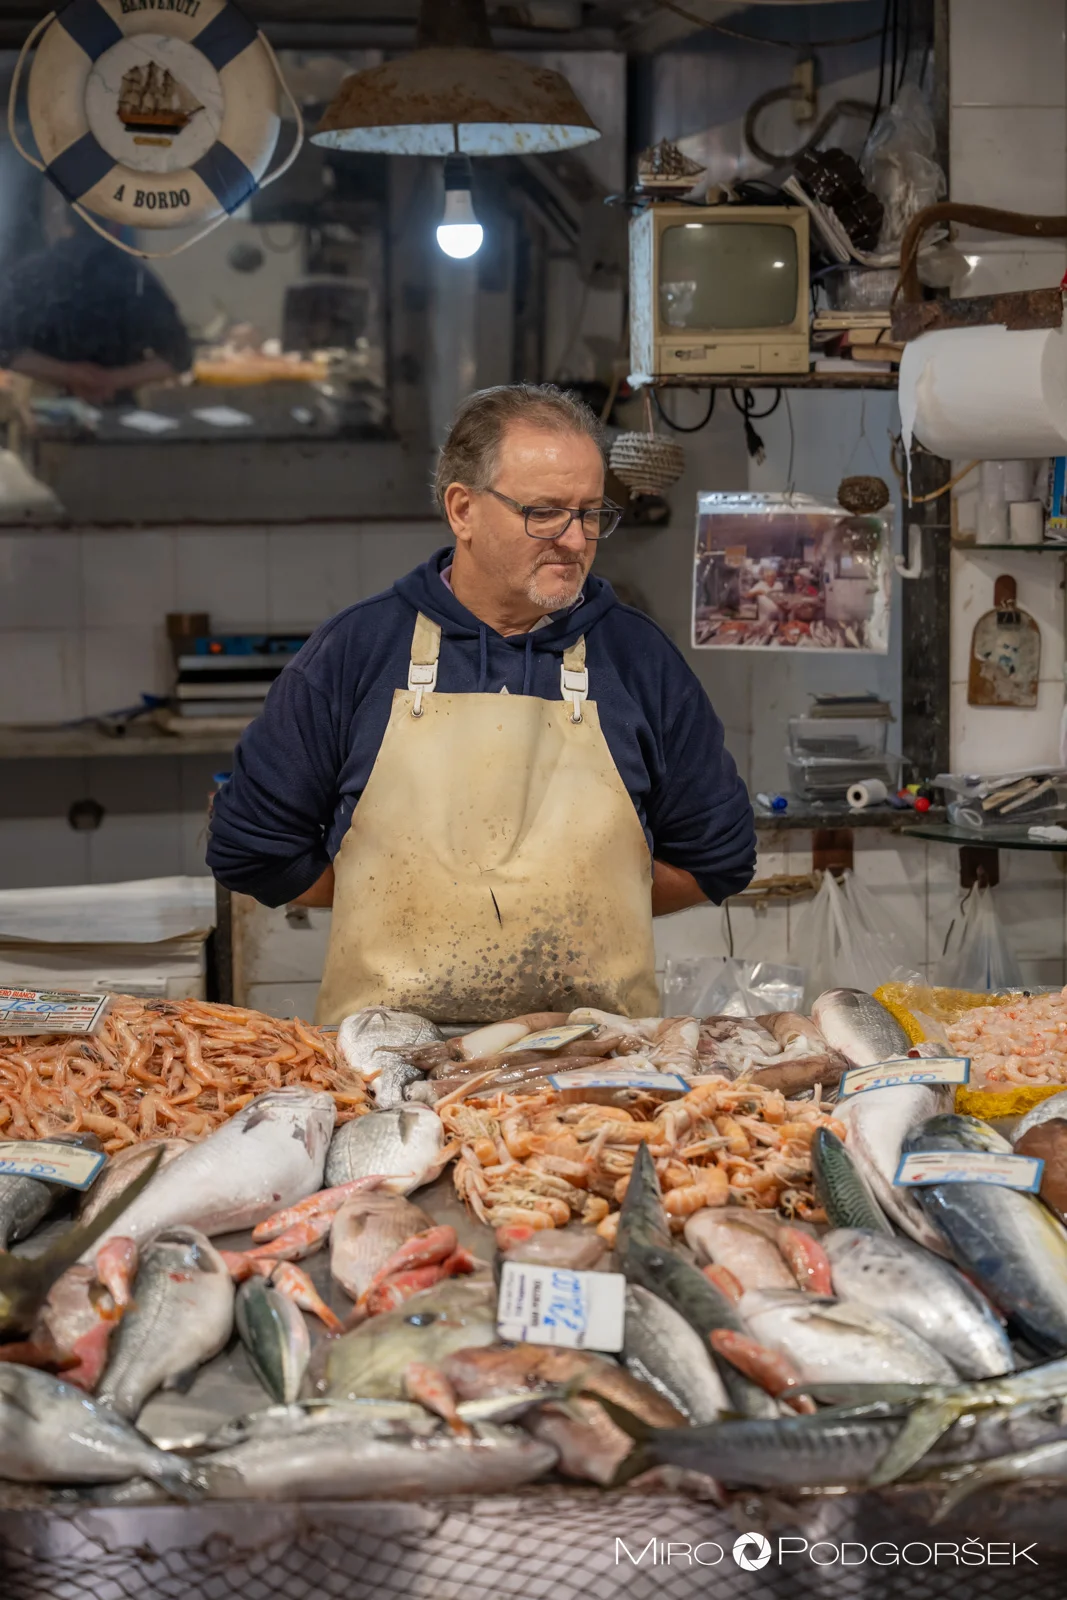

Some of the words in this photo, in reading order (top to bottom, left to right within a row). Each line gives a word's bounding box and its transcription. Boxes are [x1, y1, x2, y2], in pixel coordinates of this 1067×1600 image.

[112, 184, 126, 202] A
[133, 188, 191, 210] BORDO
[12, 990, 36, 999] BIANCO
